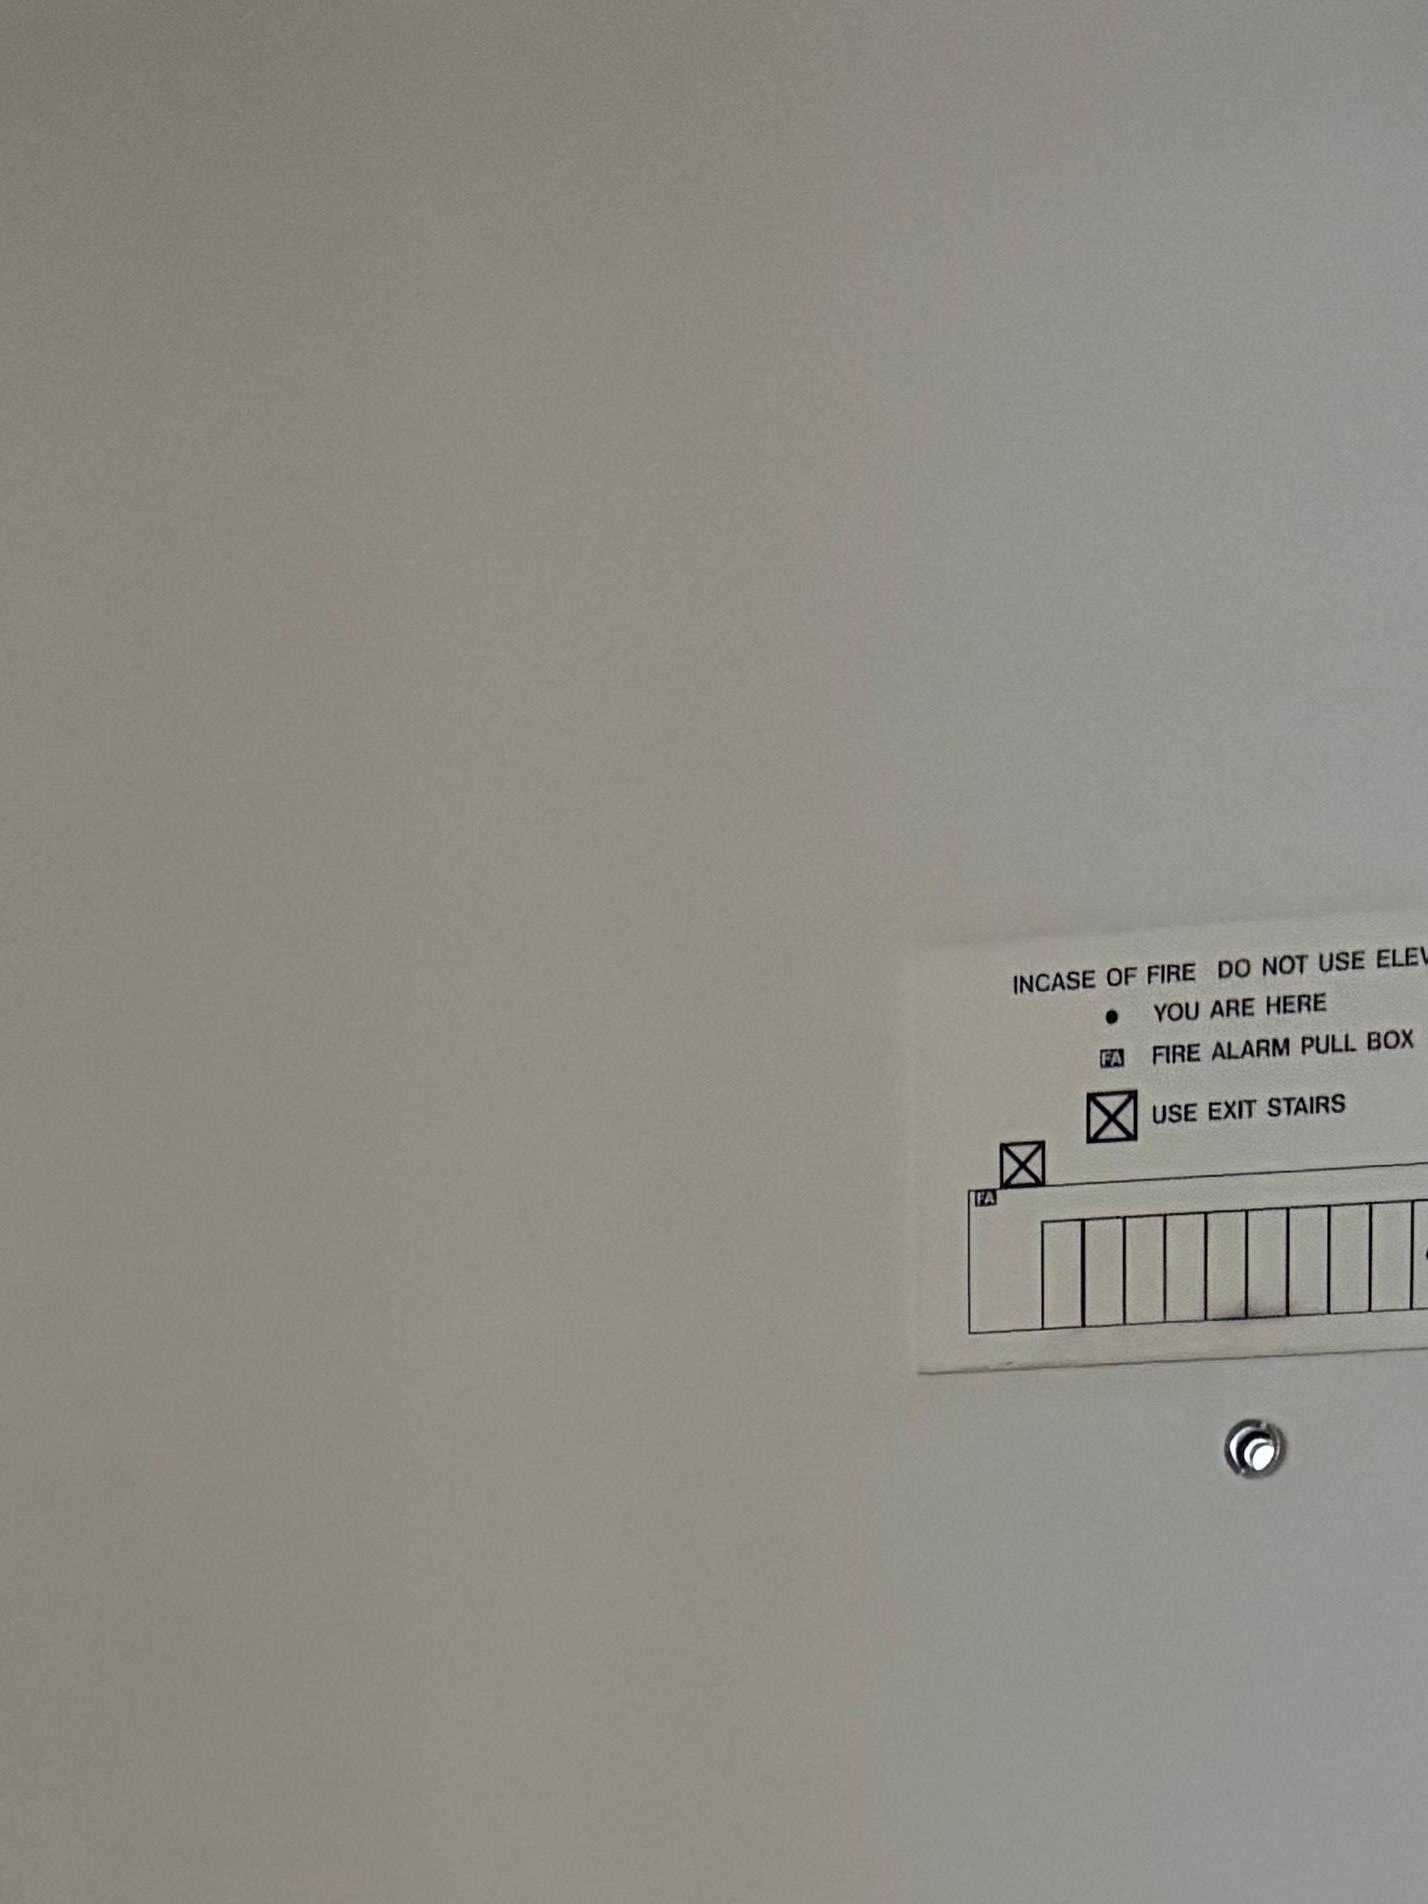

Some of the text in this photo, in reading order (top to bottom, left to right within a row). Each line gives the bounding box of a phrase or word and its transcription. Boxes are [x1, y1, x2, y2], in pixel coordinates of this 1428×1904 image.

[1013, 969, 1096, 995] INCASE
[1106, 966, 1138, 987] OF
[1147, 962, 1196, 985] FIRE
[1218, 958, 1251, 980] DO
[1262, 954, 1309, 977] NOT
[1318, 950, 1365, 973] USE
[1153, 992, 1327, 1023] YOU ARE HERE
[1101, 1028, 1414, 1067] FA FIRE ALARM PULL BOX
[1152, 1093, 1346, 1125] USE EXIT STAIRS
